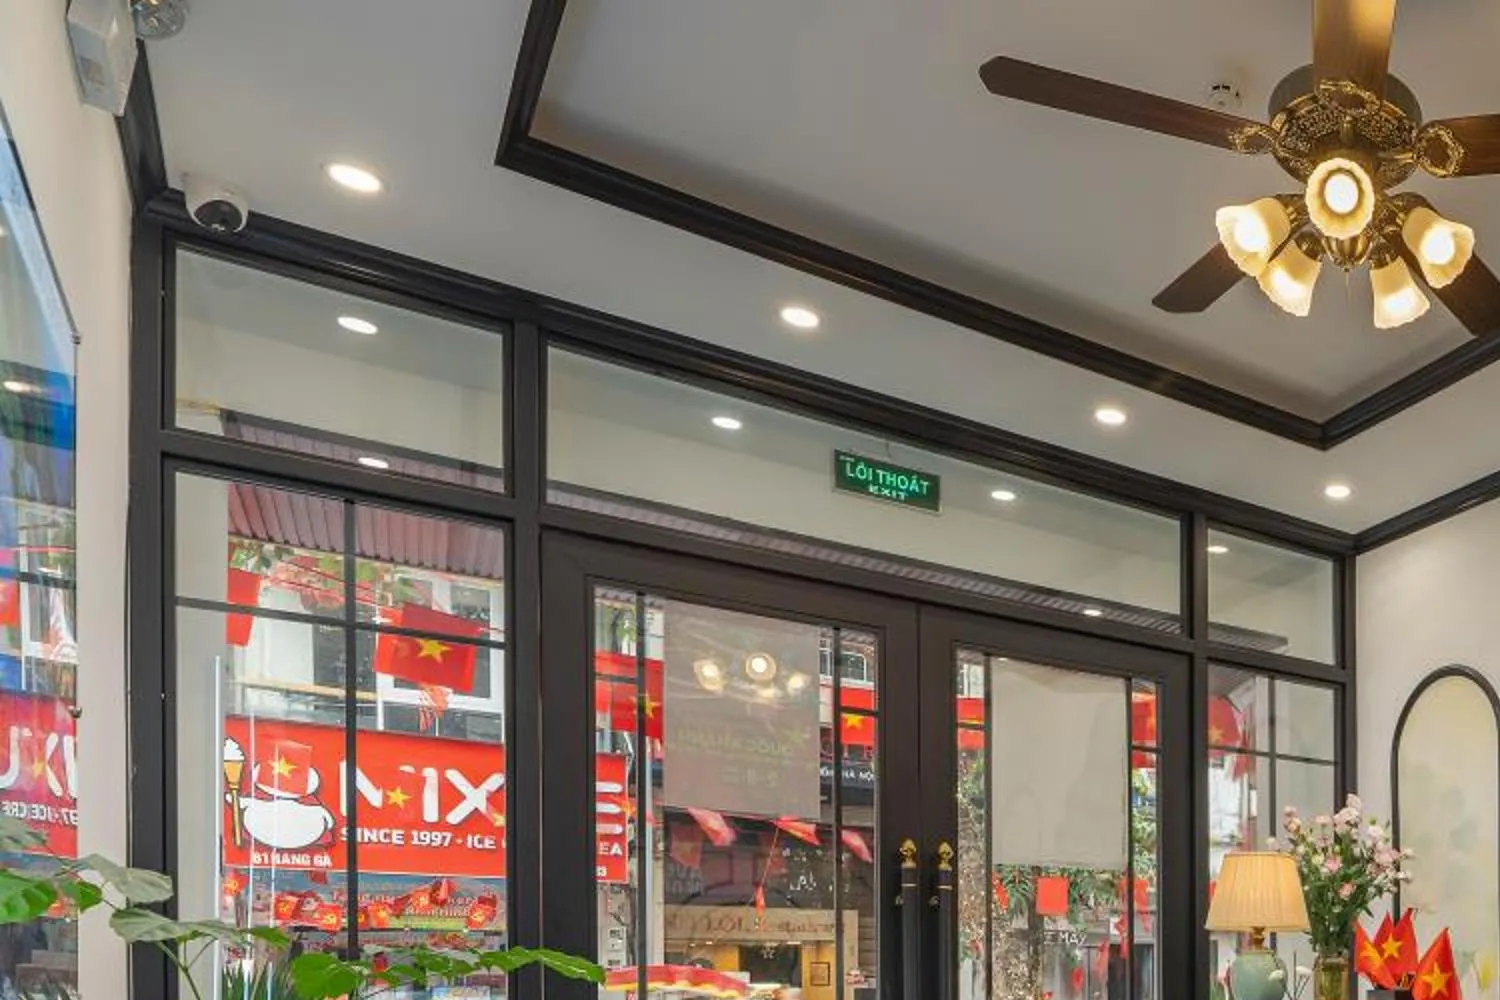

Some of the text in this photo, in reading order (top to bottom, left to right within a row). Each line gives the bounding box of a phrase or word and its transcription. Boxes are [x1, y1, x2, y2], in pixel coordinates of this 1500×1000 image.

[868, 484, 906, 500] EXIT
[411, 829, 453, 848] 1997
[465, 833, 497, 849] ICE
